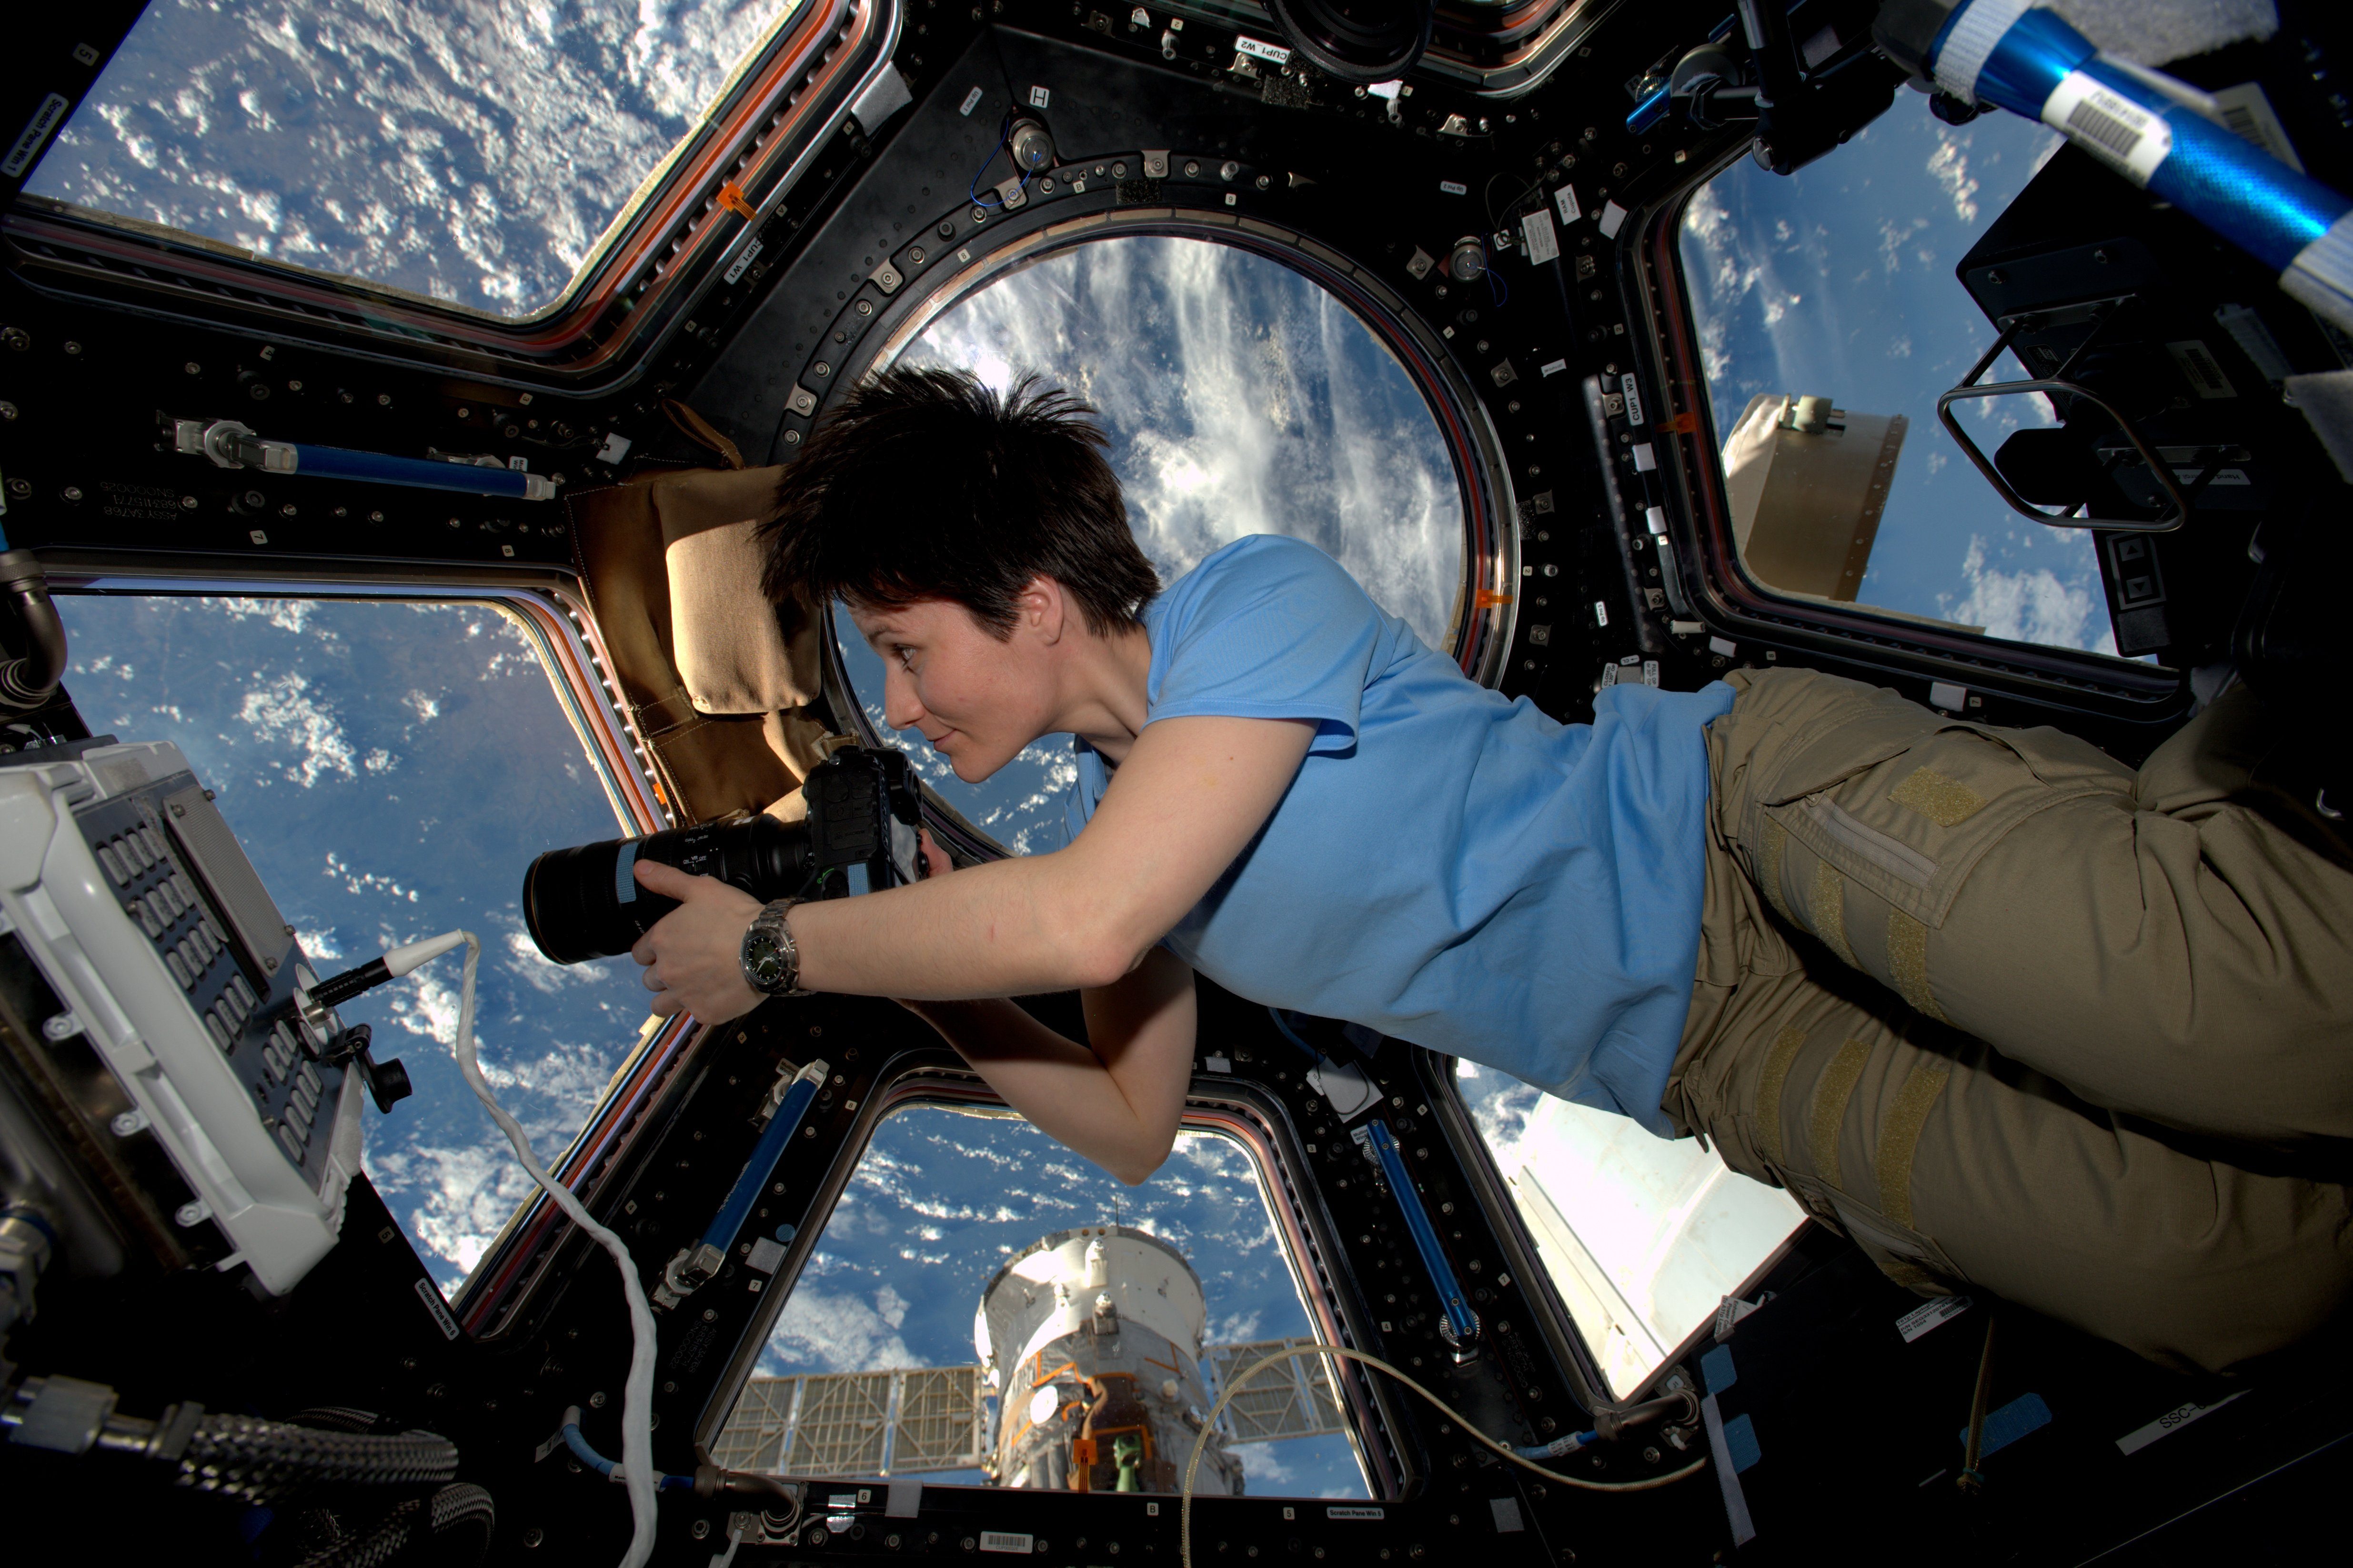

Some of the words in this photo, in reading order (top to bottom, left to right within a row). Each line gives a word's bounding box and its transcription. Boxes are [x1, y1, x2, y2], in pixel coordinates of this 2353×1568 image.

[80, 49, 93, 60] 5
[1241, 41, 1287, 60] CUP1_W2
[966, 99, 974, 108] Pnl
[1033, 89, 1046, 105] H
[36, 99, 62, 129] Scratch
[22, 129, 41, 149] Pane
[11, 150, 28, 164] Win
[1567, 192, 1576, 213] Cupola
[1625, 378, 1643, 421] CUP1_W3
[100, 482, 174, 498] SN000025
[113, 495, 176, 509] 683-11577-1
[104, 506, 143, 518] 3A768
[148, 510, 177, 520] ASSY
[419, 1282, 435, 1306] Scratch
[433, 1304, 444, 1320] Pane
[442, 1318, 452, 1331] Win
[1730, 1300, 1739, 1327] Enhanced
[1910, 1303, 1931, 1317] Laptop
[1910, 1296, 1961, 1324] SEG33120761-30
[669, 1320, 702, 1368] SN000022
[703, 1328, 717, 1348] ASSY
[689, 1348, 706, 1373] 3A768
